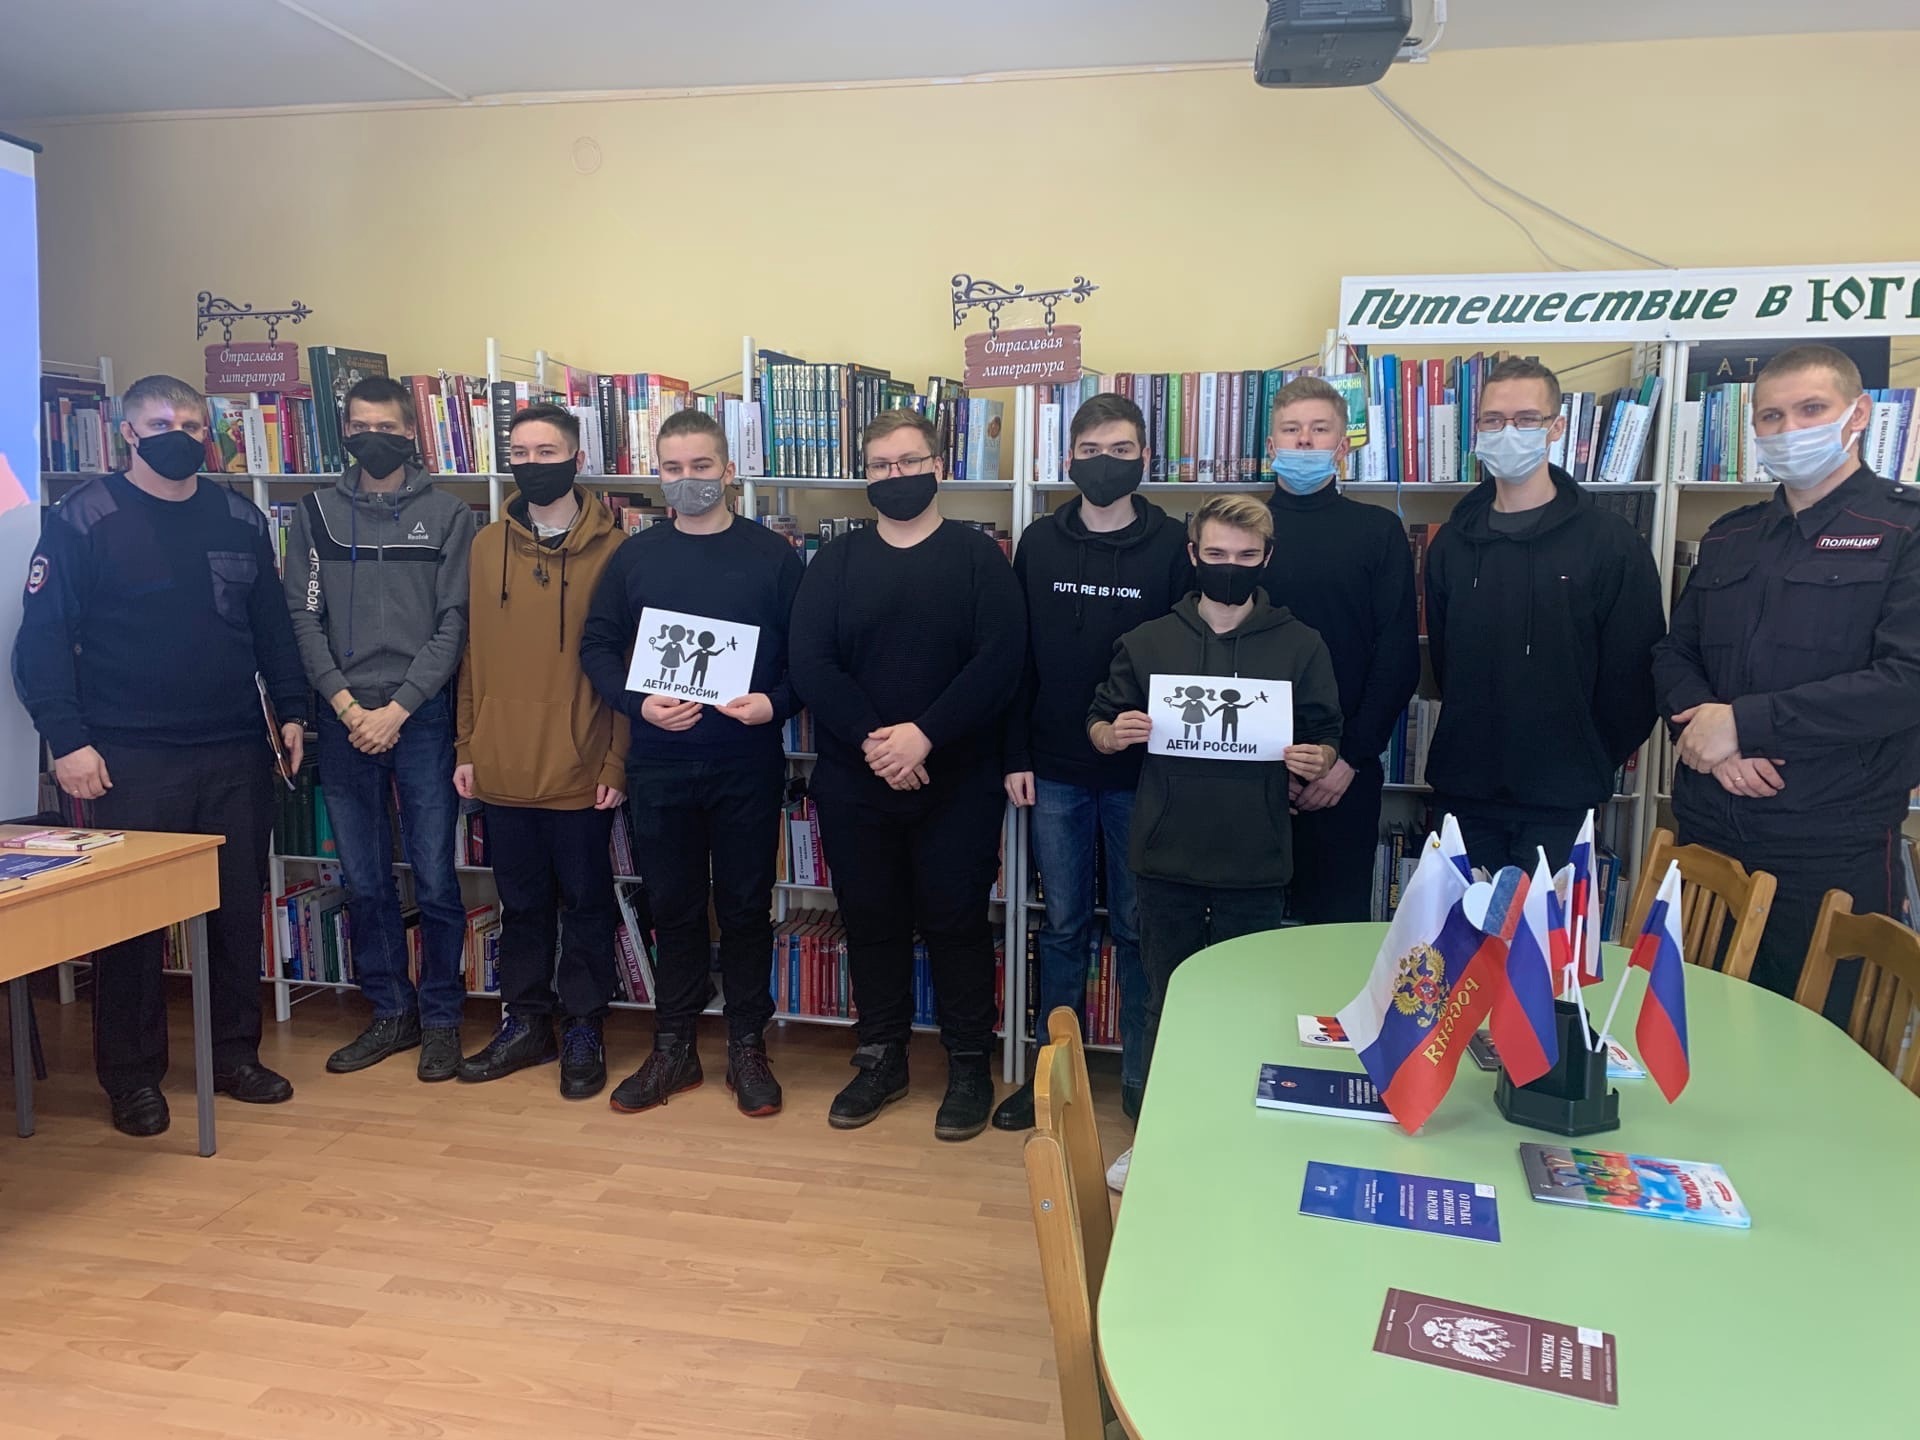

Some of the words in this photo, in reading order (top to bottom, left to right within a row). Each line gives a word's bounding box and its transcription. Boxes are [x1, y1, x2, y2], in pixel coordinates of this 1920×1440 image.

[1347, 283, 1738, 331] Путешествие
[1755, 283, 1793, 318] в
[1806, 275, 1920, 322] ЮГ
[219, 347, 285, 366] Отраслевая
[984, 335, 1065, 358] Отраслевая
[218, 368, 287, 388] литература
[982, 358, 1066, 380] литература
[1819, 535, 1881, 549] ПОЛИЦИЯ
[306, 560, 321, 612] Reebok
[1098, 585, 1110, 597] IS
[642, 678, 672, 691] ДЕТИ
[673, 684, 719, 700] РОССИИ
[1166, 738, 1199, 751] ДЕТИ
[1203, 741, 1257, 755] РОССИИ
[621, 934, 641, 984] ШОСТАКОВИЧ
[1426, 1189, 1440, 1221] НАРОДОВ
[1442, 1188, 1456, 1226] КОРЕННЫХ
[1459, 1199, 1473, 1226] ПРАВАХ
[1559, 1347, 1573, 1380] ПРАВАХ
